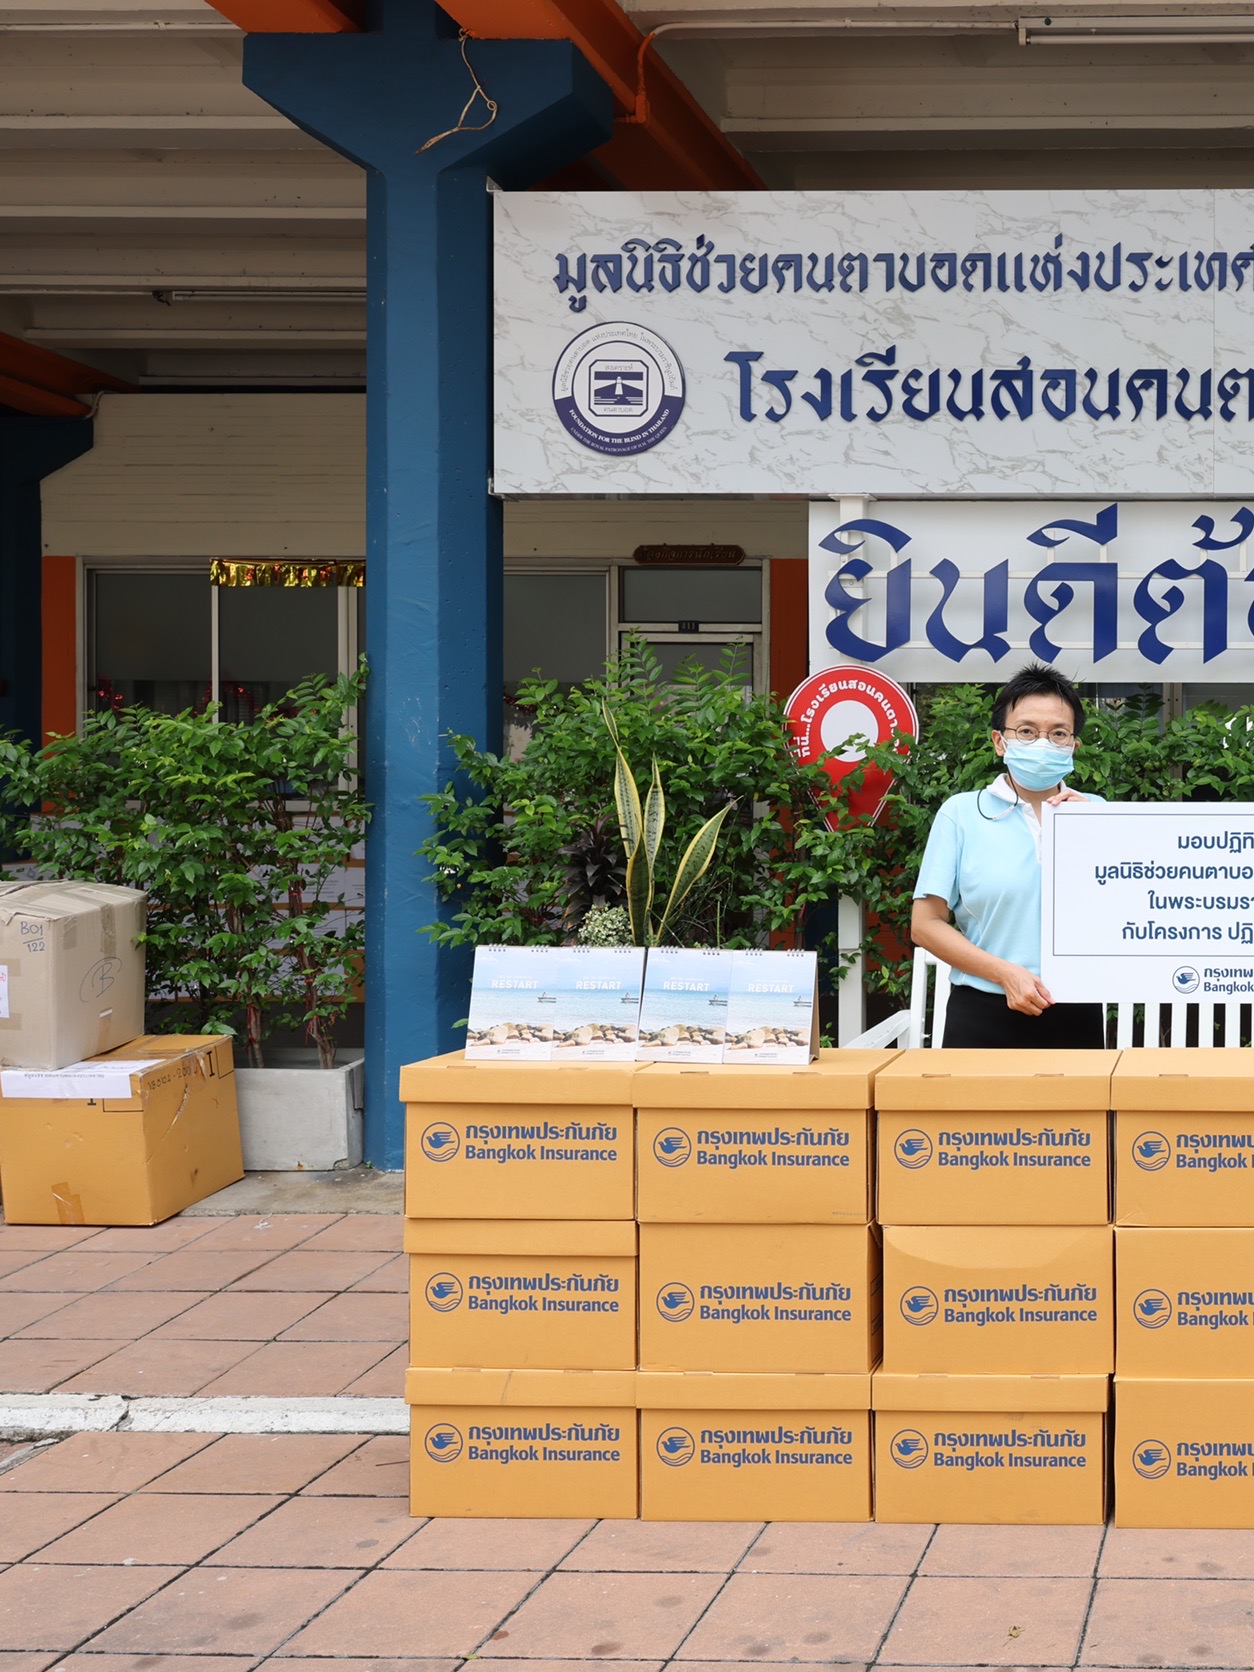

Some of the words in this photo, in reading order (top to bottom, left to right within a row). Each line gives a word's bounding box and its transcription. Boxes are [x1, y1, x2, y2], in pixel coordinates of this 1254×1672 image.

[569, 409, 598, 438] FOUNDATION
[598, 435, 610, 443] FOR
[624, 434, 642, 443] BLIND
[649, 408, 670, 434] THAILAND
[1122, 921, 1222, 940] กับโครงการ
[491, 979, 539, 990] RESTART
[576, 980, 622, 991] RESTART
[663, 981, 710, 992] RESTART
[747, 982, 795, 993] RESTART
[1203, 981, 1254, 995] Bangkok
[466, 1122, 616, 1146] กรุงเทพประกันภัย
[698, 1127, 848, 1151] กรุงเทพประกันภัย
[939, 1128, 1089, 1152] กรุงเทพประกันภัย
[466, 1143, 535, 1163] Bangkok
[540, 1145, 617, 1160] Insurance
[698, 1148, 766, 1168] Bangkok
[771, 1151, 849, 1166] Insurance
[939, 1150, 1008, 1170] Bangkok
[1013, 1151, 1090, 1166] Insurance
[1177, 1152, 1246, 1172] Bangkok
[470, 1273, 617, 1297] กรุงเทพประกันภัย
[701, 1282, 850, 1306] กรุงเทพประกันภัย
[470, 1294, 537, 1314] Bangkok
[542, 1297, 618, 1312] Insurance
[945, 1284, 1096, 1308] กรุงเทพประกันภัย
[701, 1303, 769, 1323] Bangkok
[775, 1305, 851, 1320] Insurance
[945, 1306, 1014, 1326] Bangkok
[1019, 1306, 1097, 1321] Insurance
[1178, 1309, 1247, 1329] Bangkok
[470, 1423, 619, 1447] กรุงเทพประกันภัย
[702, 1426, 851, 1450] กรุงเทพประกันภัย
[935, 1429, 1085, 1453] กรุงเทพประกันภัย
[470, 1444, 537, 1464] Bangkok
[543, 1445, 620, 1460] Insurance
[702, 1447, 770, 1467] Bangkok
[775, 1449, 852, 1464] Insurance
[935, 1450, 1003, 1470] Bangkok
[1009, 1451, 1086, 1466] Insurance
[1178, 1460, 1247, 1480] Bangkok
